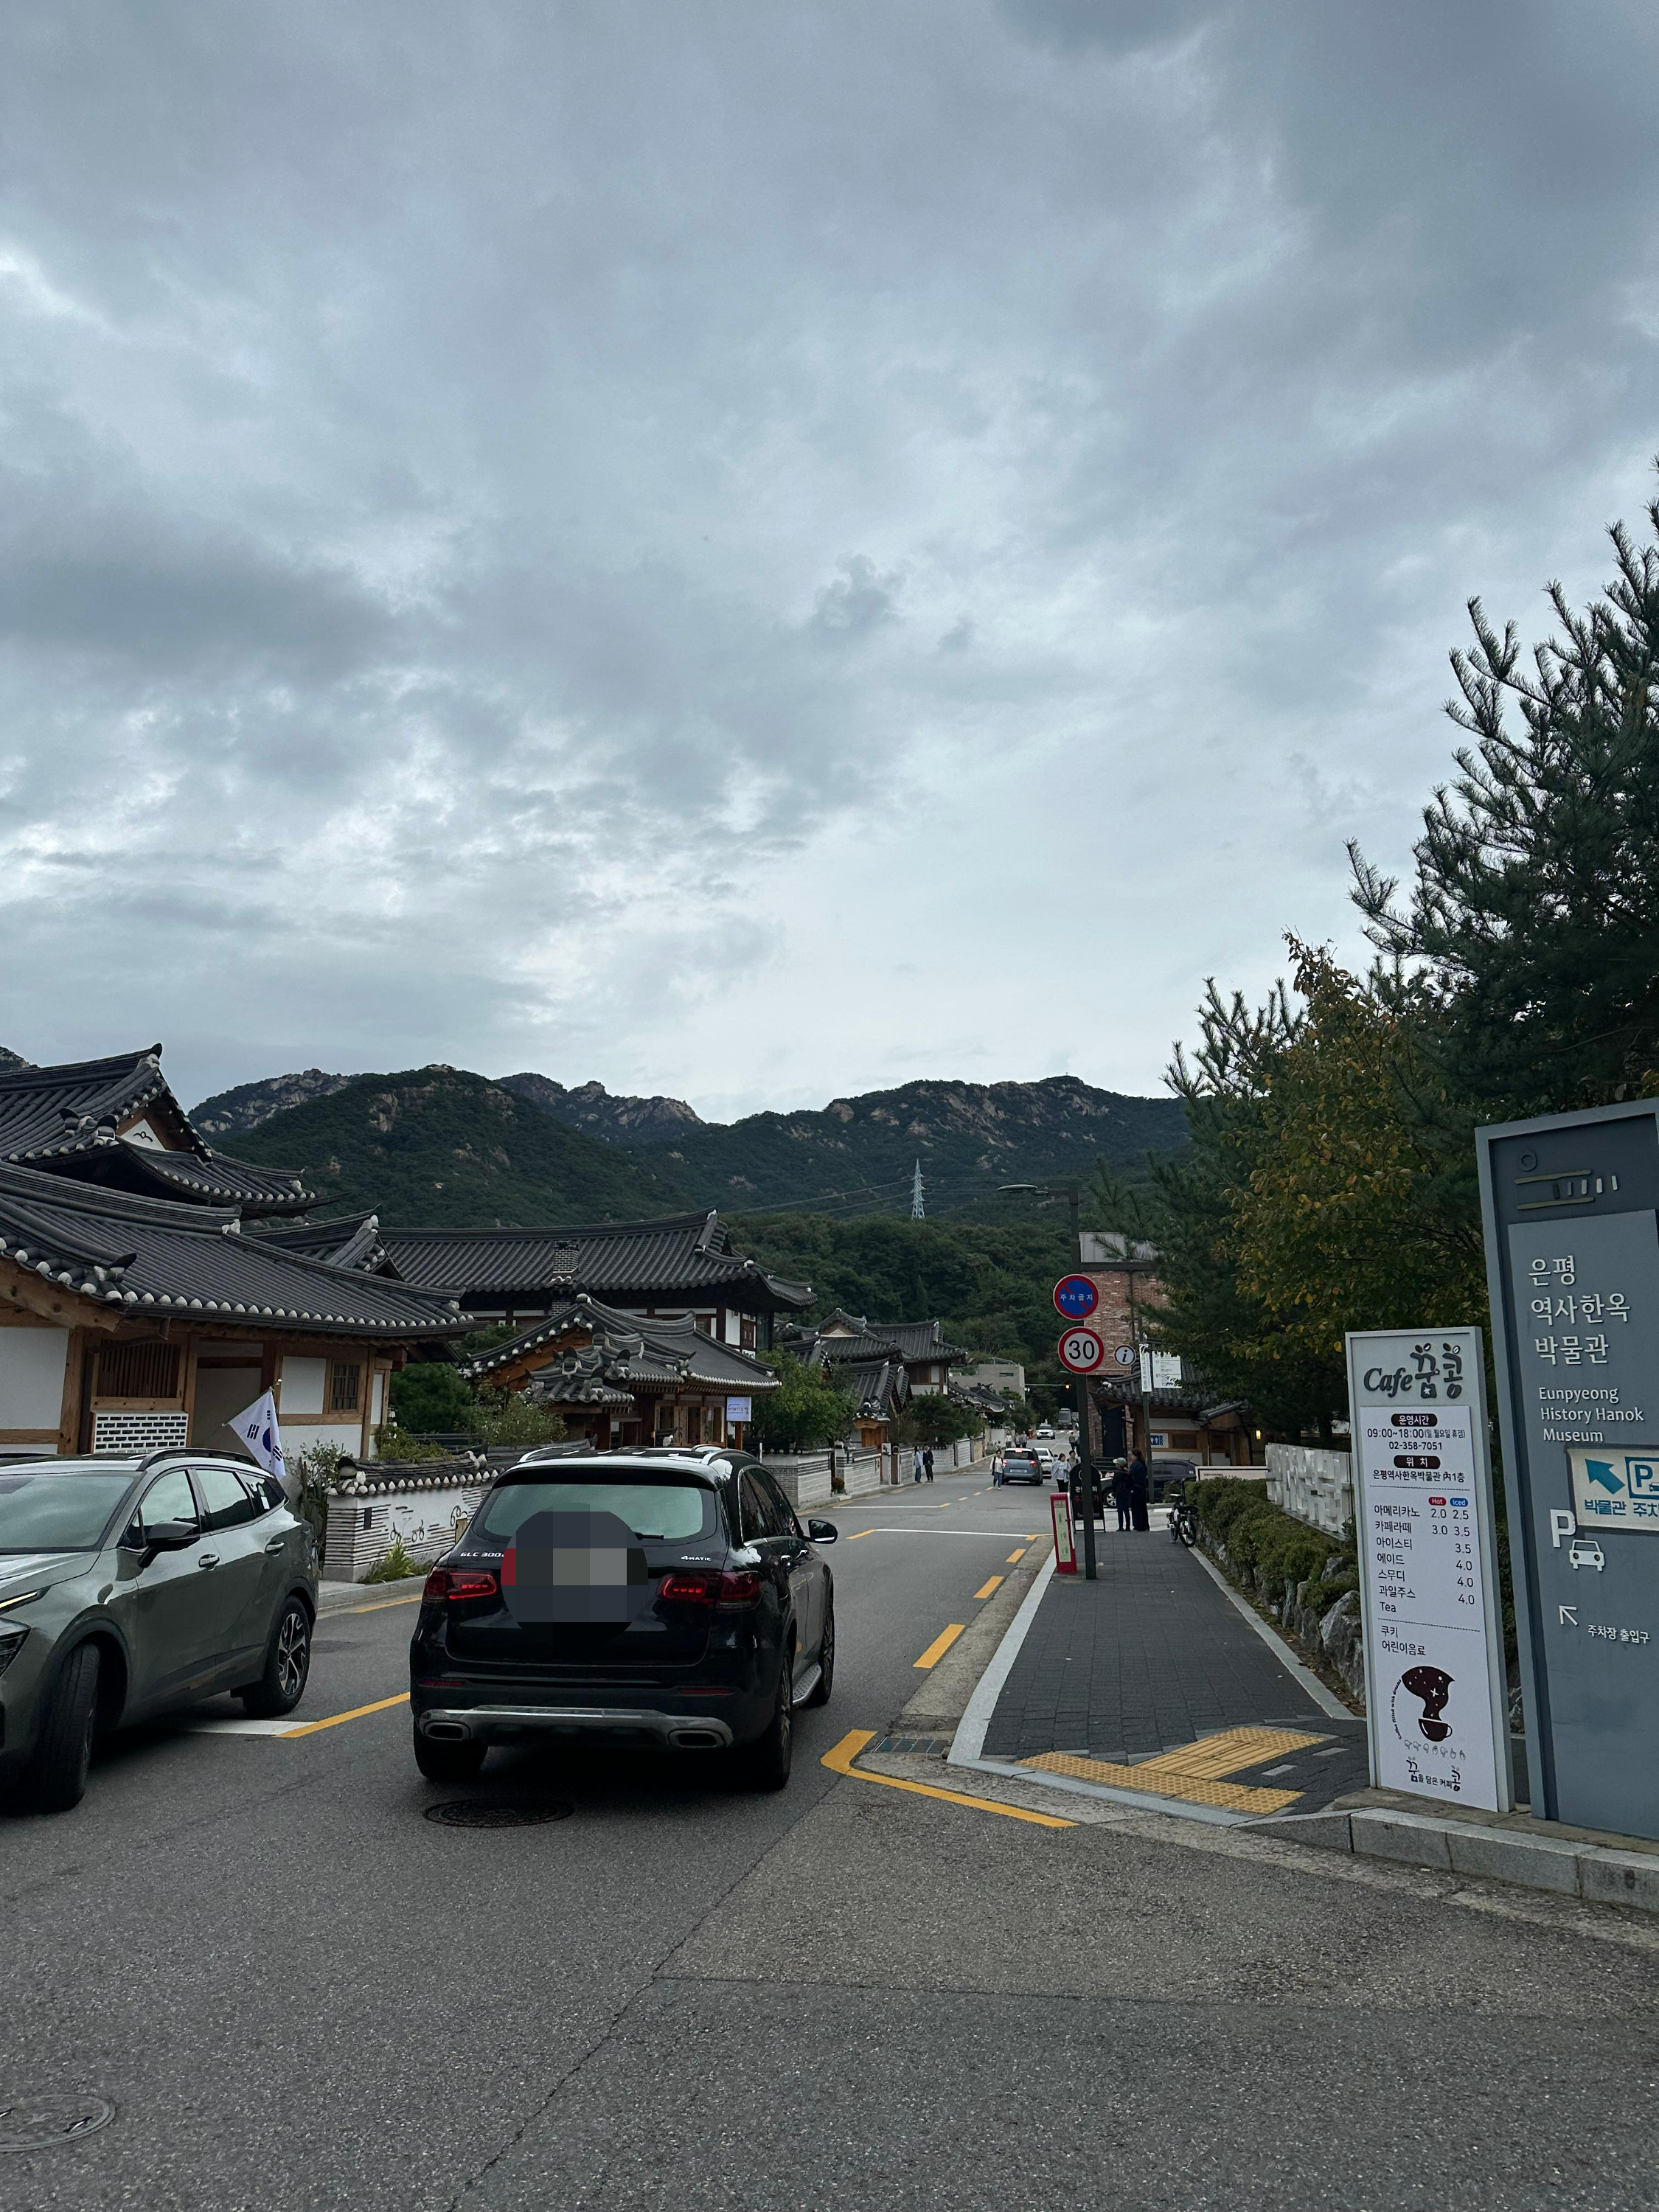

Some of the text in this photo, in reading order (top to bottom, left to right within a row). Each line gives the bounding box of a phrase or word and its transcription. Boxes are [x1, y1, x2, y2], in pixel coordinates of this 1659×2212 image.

[1528, 1255, 1576, 1286] 은평
[1531, 1293, 1631, 1326] 역사한옥
[1068, 1340, 1095, 1360] 30
[1534, 1334, 1610, 1366] 박물관
[1363, 1367, 1413, 1398] Cafe
[1539, 1387, 1619, 1404] Eunpyeong
[1398, 1415, 1430, 1425] 운영시간
[1540, 1406, 1644, 1425] History Hanok
[1543, 1428, 1604, 1442] Museum
[1388, 1441, 1443, 1450] 02-358-7051
[1373, 1470, 1441, 1482] 은평역사한옥박물관
[1635, 1464, 1653, 1488] P
[1374, 1505, 1470, 1520] 아메리카노 2.0 2.5
[1585, 1499, 1627, 1516] 박물관
[1375, 1520, 1470, 1537] 카페라떼 3.0 3.5
[1550, 1509, 1576, 1548] P
[1376, 1537, 1472, 1554] 아이스티 3.5
[1377, 1553, 1472, 1571] 에이드 4.0
[1378, 1568, 1474, 1587] 스무디 4.0
[1379, 1585, 1475, 1604] 과일주스 4.0
[1379, 1601, 1397, 1613] Tea
[1381, 1625, 1399, 1638] 쿠키
[1587, 1624, 1650, 1644] 주차장 출입구
[1382, 1640, 1427, 1656] 어린이음료
[1425, 1775, 1439, 1786] 담은
